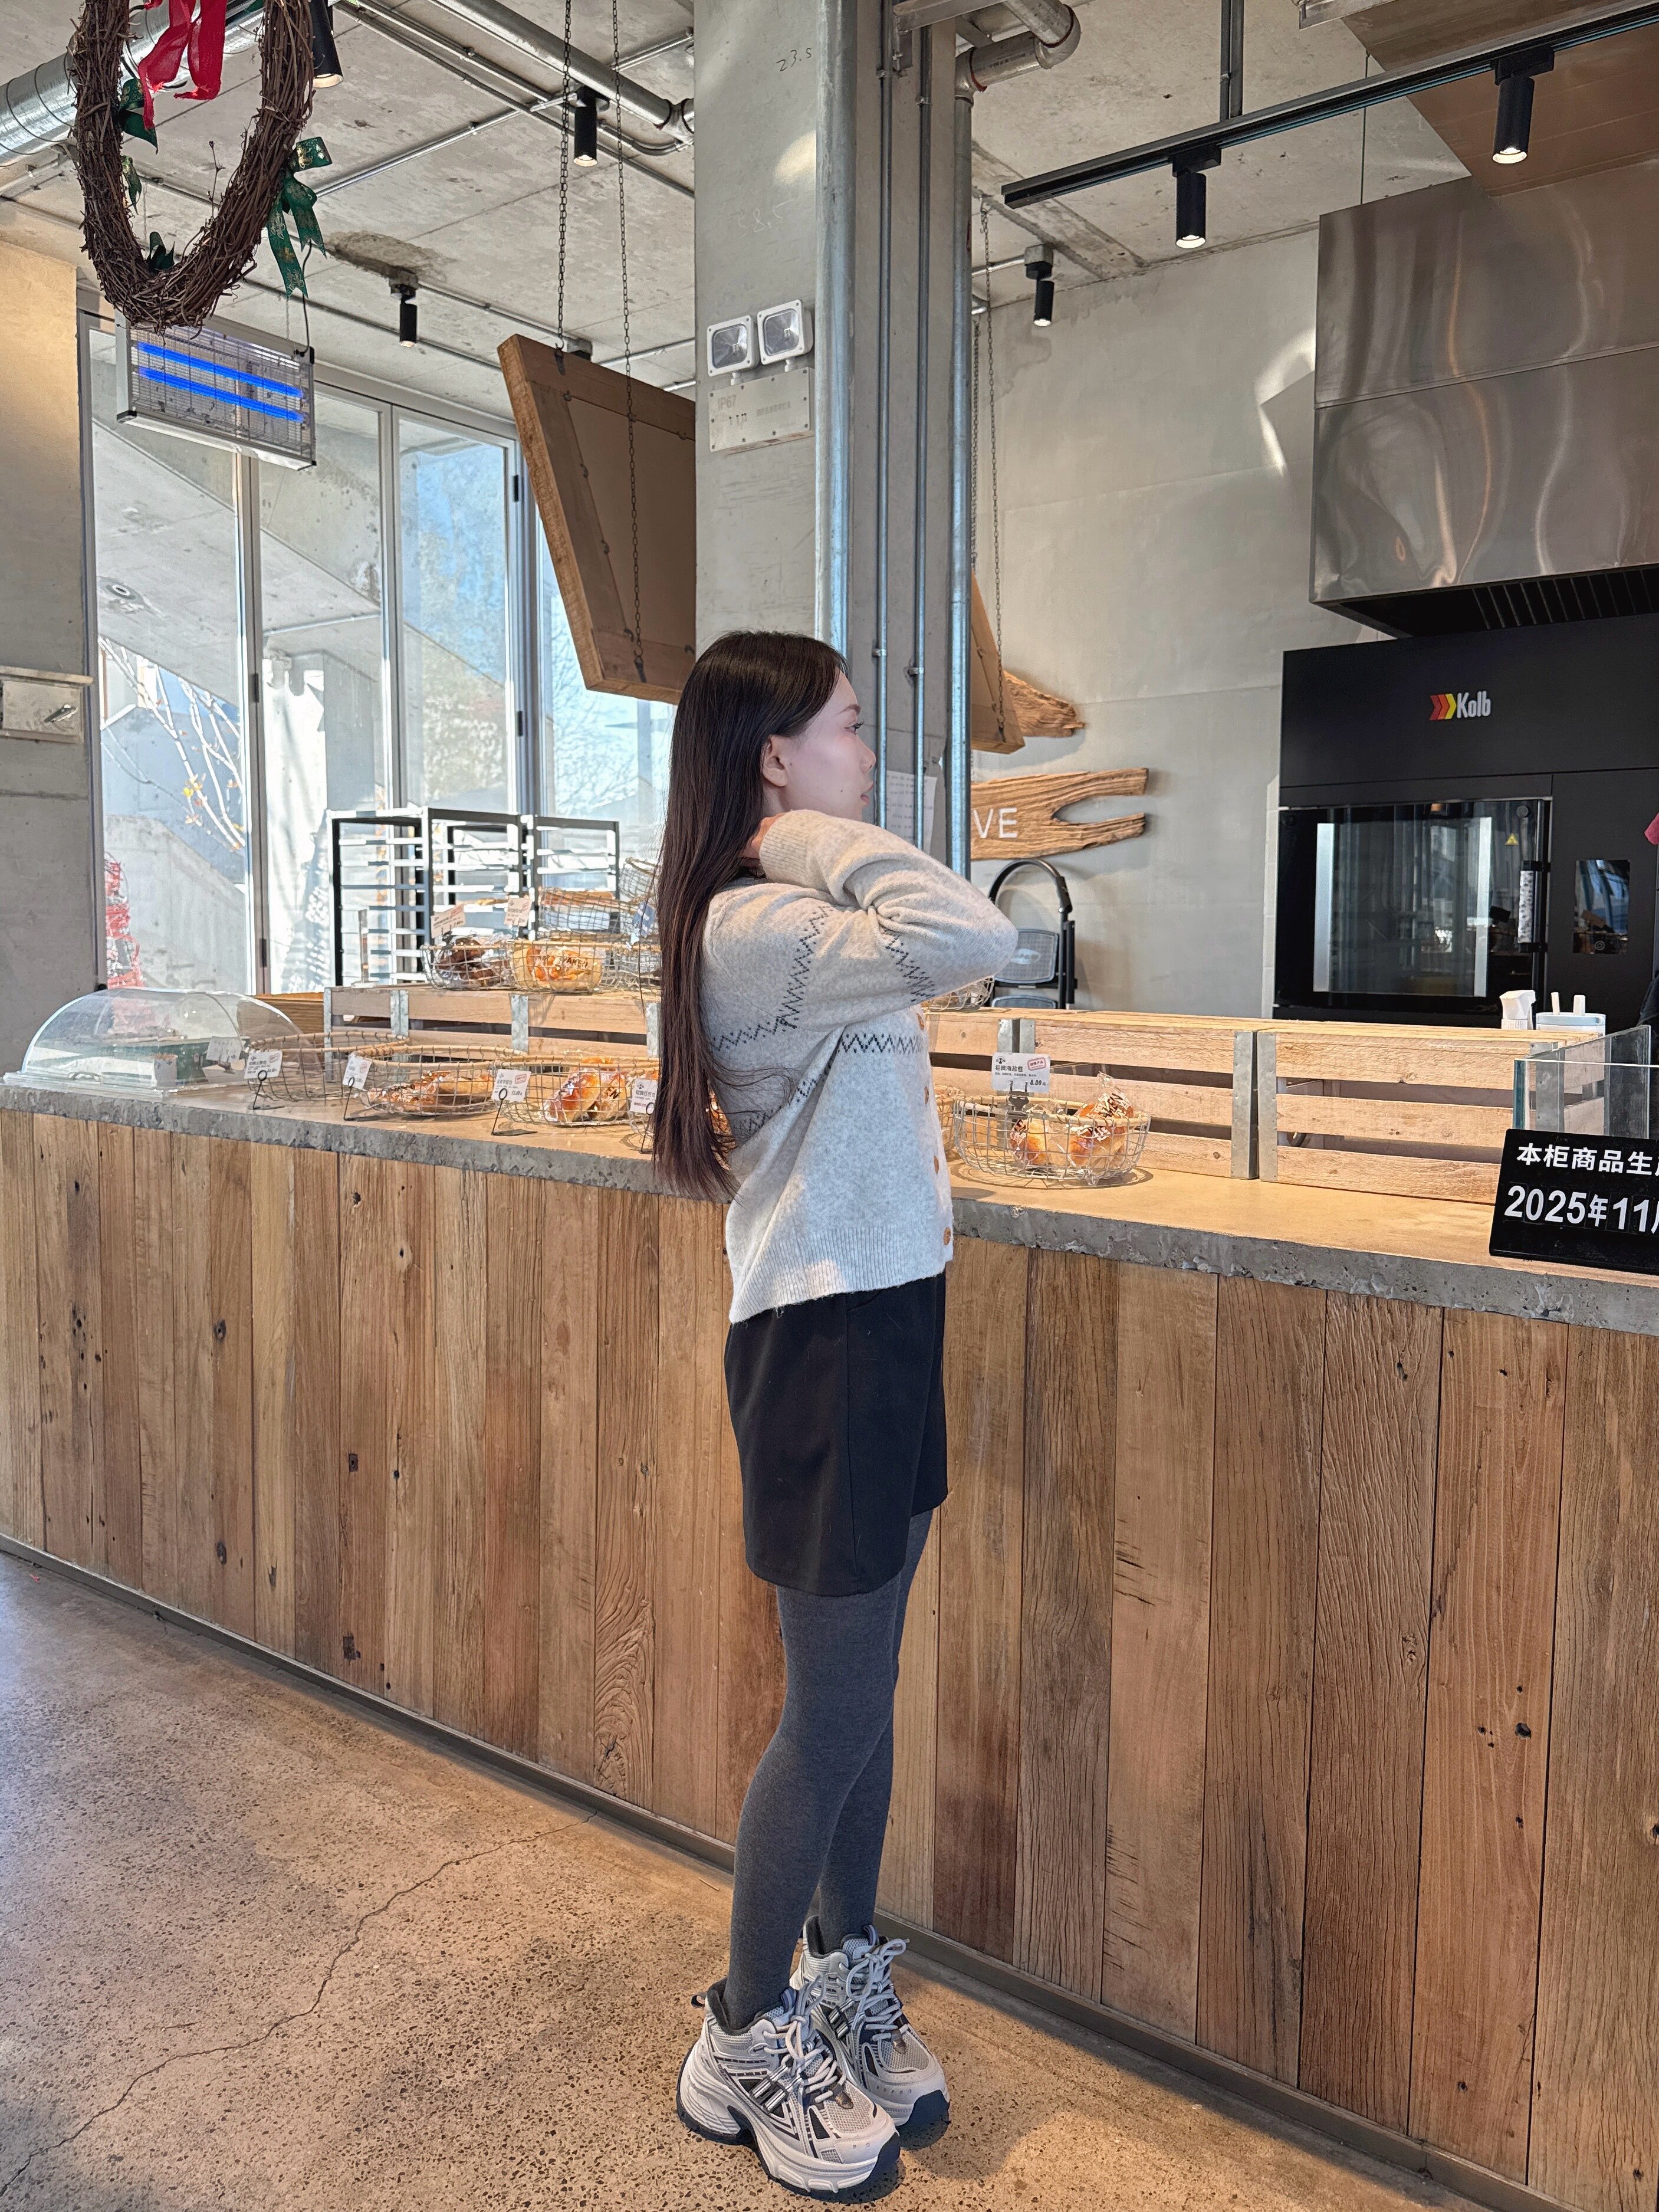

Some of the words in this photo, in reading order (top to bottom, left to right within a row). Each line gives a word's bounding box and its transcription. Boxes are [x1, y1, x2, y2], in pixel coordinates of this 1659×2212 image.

[776, 47, 812, 71] 23.5
[717, 394, 737, 411] IP67
[1456, 691, 1491, 718] Kolb
[1516, 1143, 1659, 1177] 本柜商品生
[1504, 1184, 1659, 1234] 2025年11
